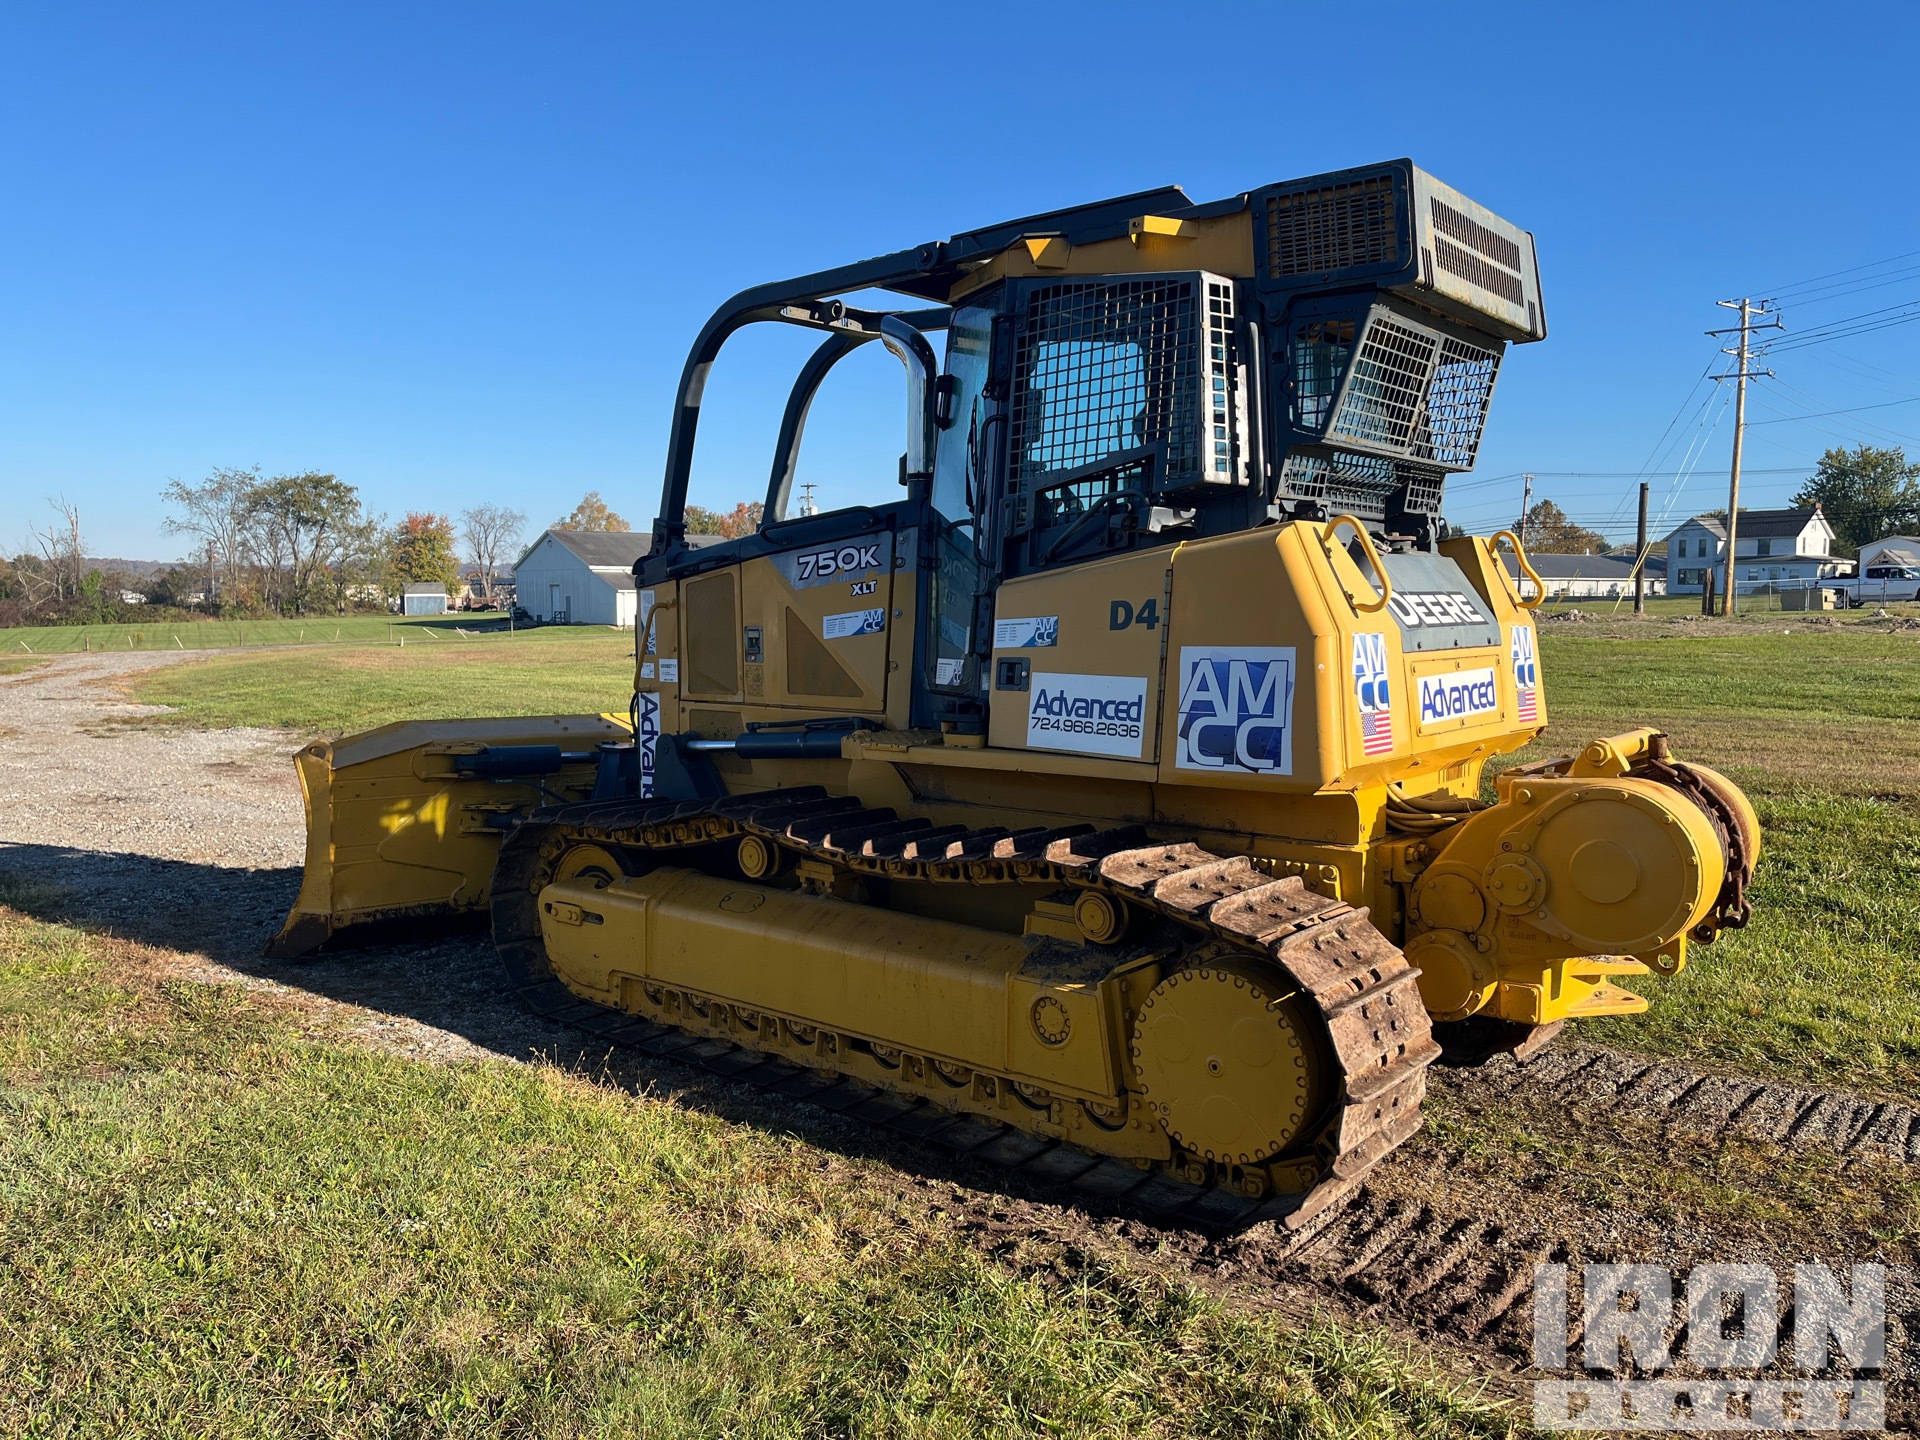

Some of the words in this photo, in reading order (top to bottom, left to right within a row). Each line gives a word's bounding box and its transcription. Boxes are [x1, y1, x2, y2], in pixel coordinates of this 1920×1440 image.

[797, 543, 882, 581] 750K
[850, 580, 878, 597] XLT
[863, 609, 882, 622] AM
[1109, 599, 1160, 631] D4
[1372, 585, 1489, 629] DEERE
[863, 620, 881, 631] CC
[1035, 630, 1053, 642] CC
[1036, 617, 1055, 632] AM
[1353, 633, 1388, 675] AM
[1511, 626, 1534, 658] AM
[1179, 658, 1289, 718] AM
[1512, 657, 1536, 688] CC
[1032, 688, 1143, 722] Advanced
[1356, 673, 1391, 713] CC
[1422, 671, 1496, 721] Advanced
[1031, 716, 1140, 738] 724.966.2636
[1187, 714, 1284, 770] CC
[640, 692, 659, 799] Advanc
